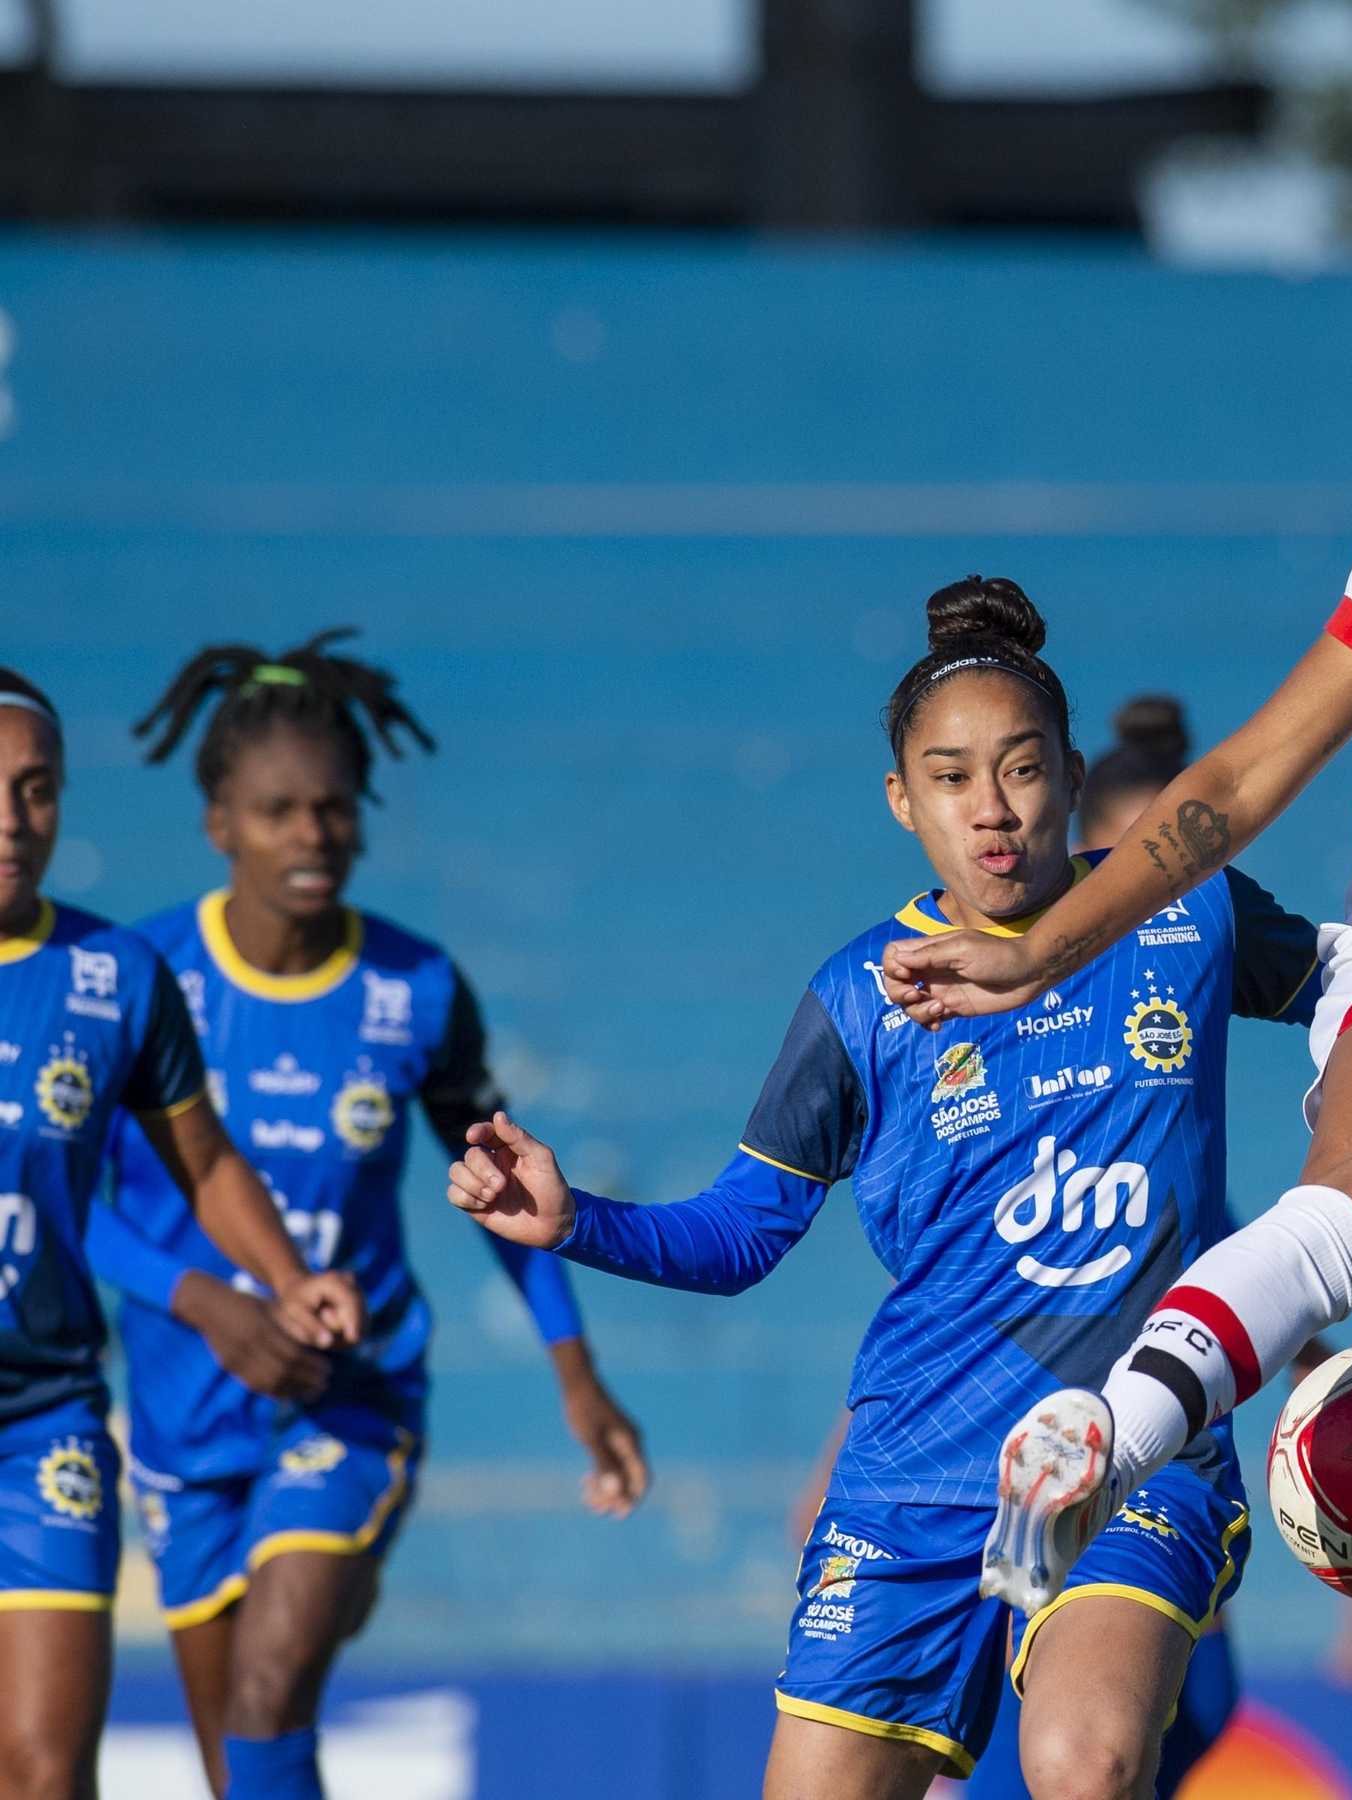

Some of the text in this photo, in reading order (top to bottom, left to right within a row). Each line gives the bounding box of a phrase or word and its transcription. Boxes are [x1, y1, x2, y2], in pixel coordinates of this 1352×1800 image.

[930, 656, 978, 681] adidas
[1137, 924, 1196, 936] MERCADINHO
[1138, 930, 1201, 947] PIRATININGA
[1016, 1006, 1094, 1036] Hausty
[1022, 1064, 1112, 1099] UniVap
[1134, 1078, 1167, 1088] FUTEBOL
[930, 1106, 960, 1128] SÃO
[959, 1090, 999, 1118] JOSÉ
[935, 1107, 1002, 1141] DOS CAMPOS
[1105, 1526, 1140, 1535] FUTEBOL
[819, 1605, 855, 1622] JOSÉ
[813, 1618, 852, 1634] CAMPOS
